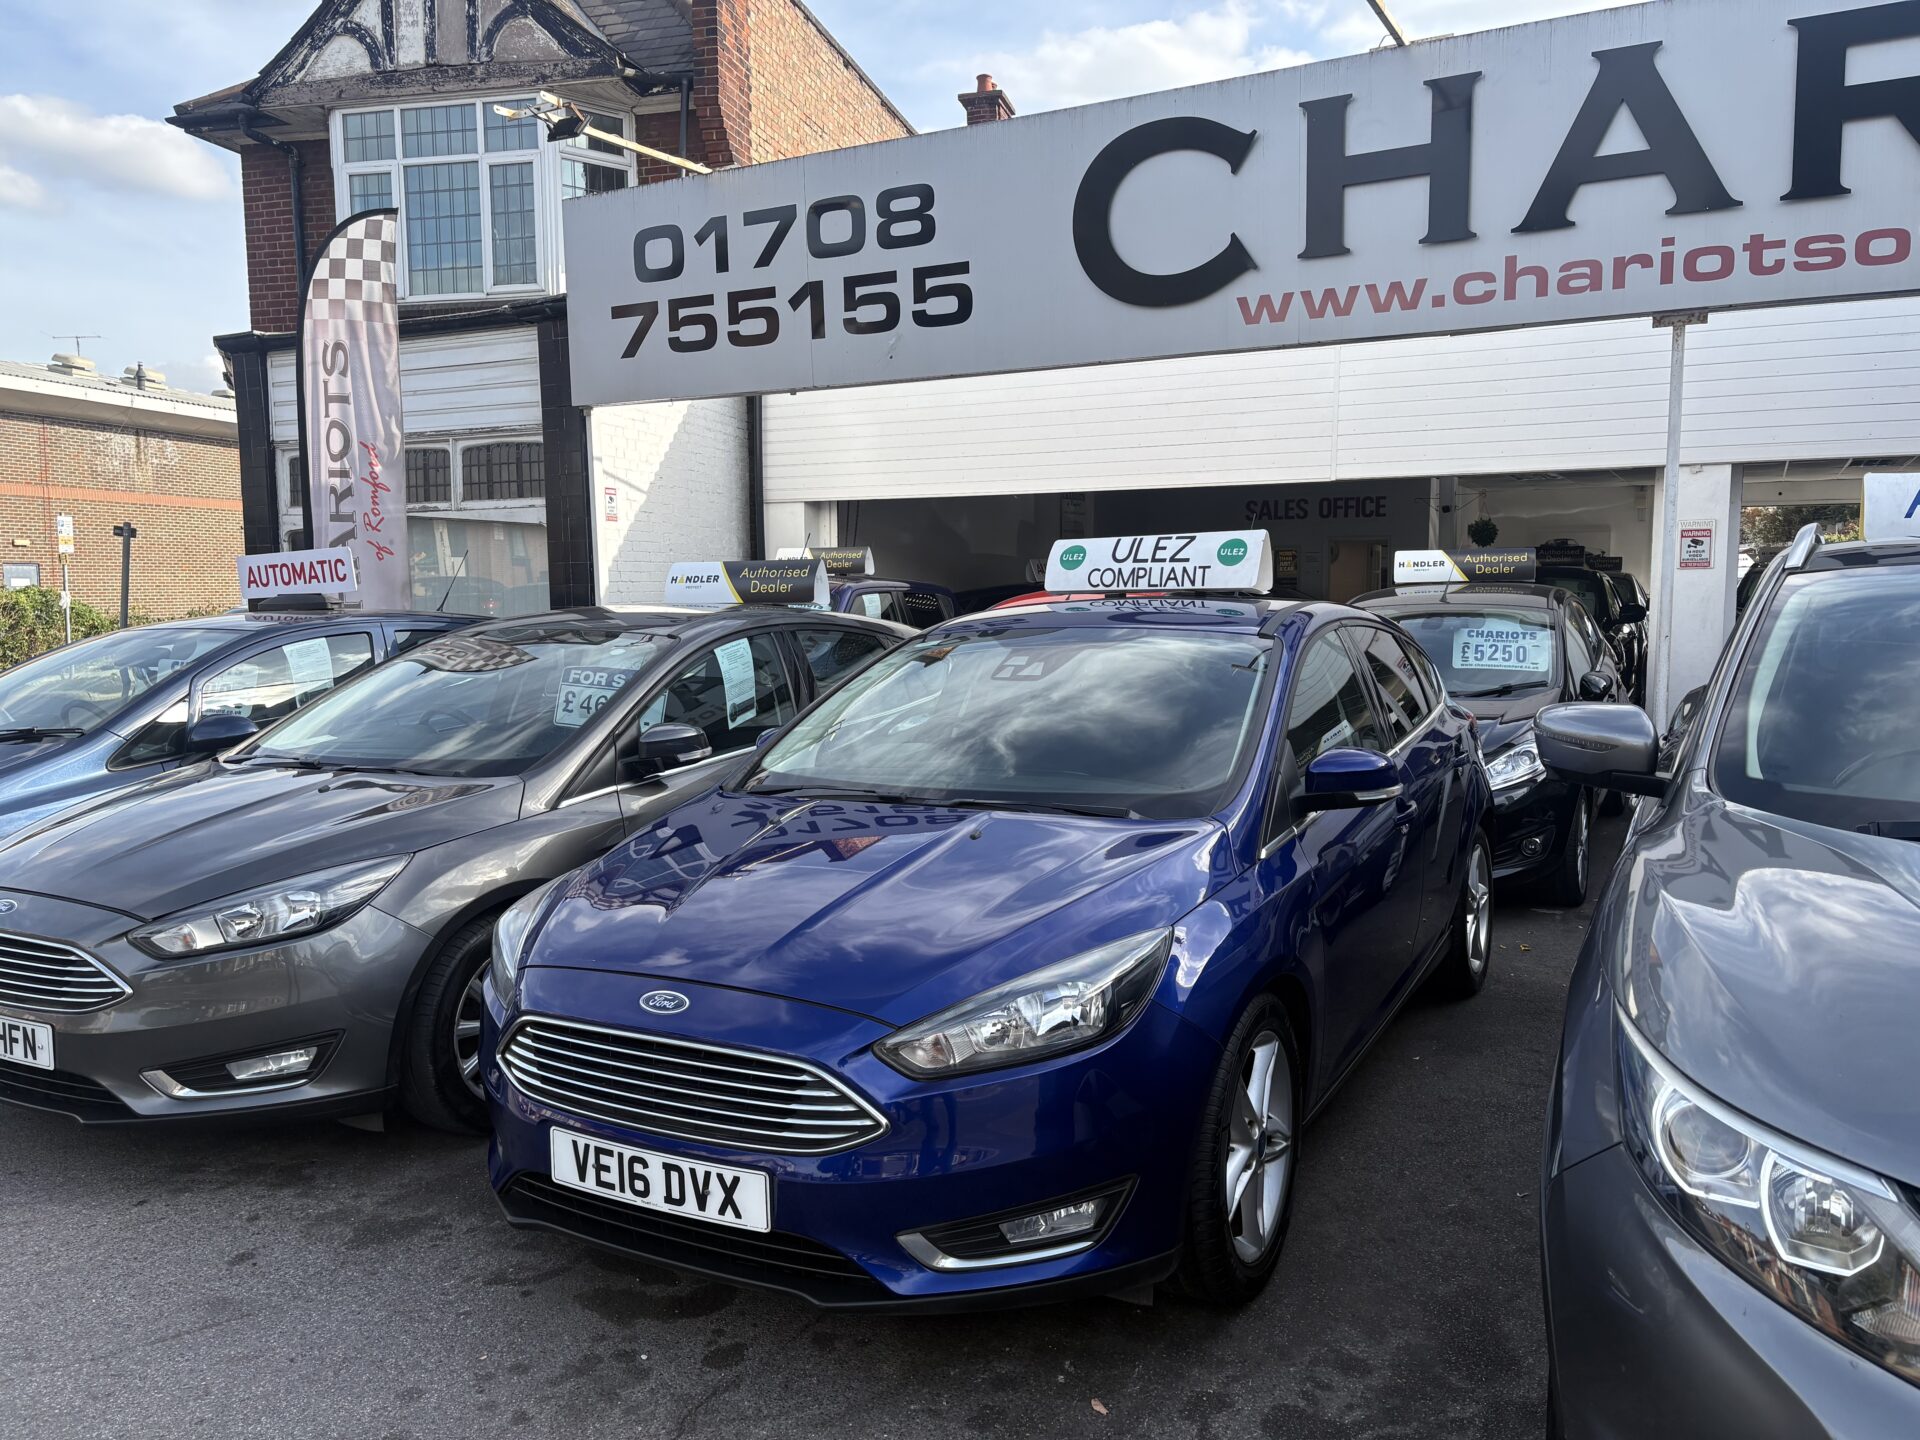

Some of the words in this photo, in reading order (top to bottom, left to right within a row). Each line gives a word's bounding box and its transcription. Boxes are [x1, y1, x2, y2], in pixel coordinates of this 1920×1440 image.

[1073, 0, 1920, 307] CHAR
[633, 183, 936, 283] 01708
[1236, 227, 1912, 325] www.chariotso
[611, 261, 973, 359] 755155
[360, 441, 391, 533] Romford
[1244, 498, 1309, 521] SALES
[1318, 496, 1387, 519] OFFICE
[367, 539, 395, 561] of
[820, 550, 863, 559] Authorised
[1062, 552, 1084, 562] ULEZ
[1111, 535, 1197, 564] ULEZ
[1219, 546, 1245, 557] ULEZ
[1463, 552, 1528, 563] Authorised
[739, 564, 811, 579] Authorised
[826, 559, 853, 568] Dealer
[1398, 560, 1445, 568] HANDLER
[1475, 564, 1515, 574] Dealer
[247, 558, 347, 589] AUTOMATIC
[670, 574, 720, 585] HANDLER
[1087, 565, 1211, 588] COMPLIANT
[750, 580, 794, 593] Dealer
[1467, 629, 1537, 640] CHARIOTS
[1461, 643, 1527, 663] £5250
[568, 669, 608, 686] FOR
[648, 994, 679, 1009] Ford
[571, 1139, 651, 1200] VE16
[661, 1161, 743, 1220] DVX
